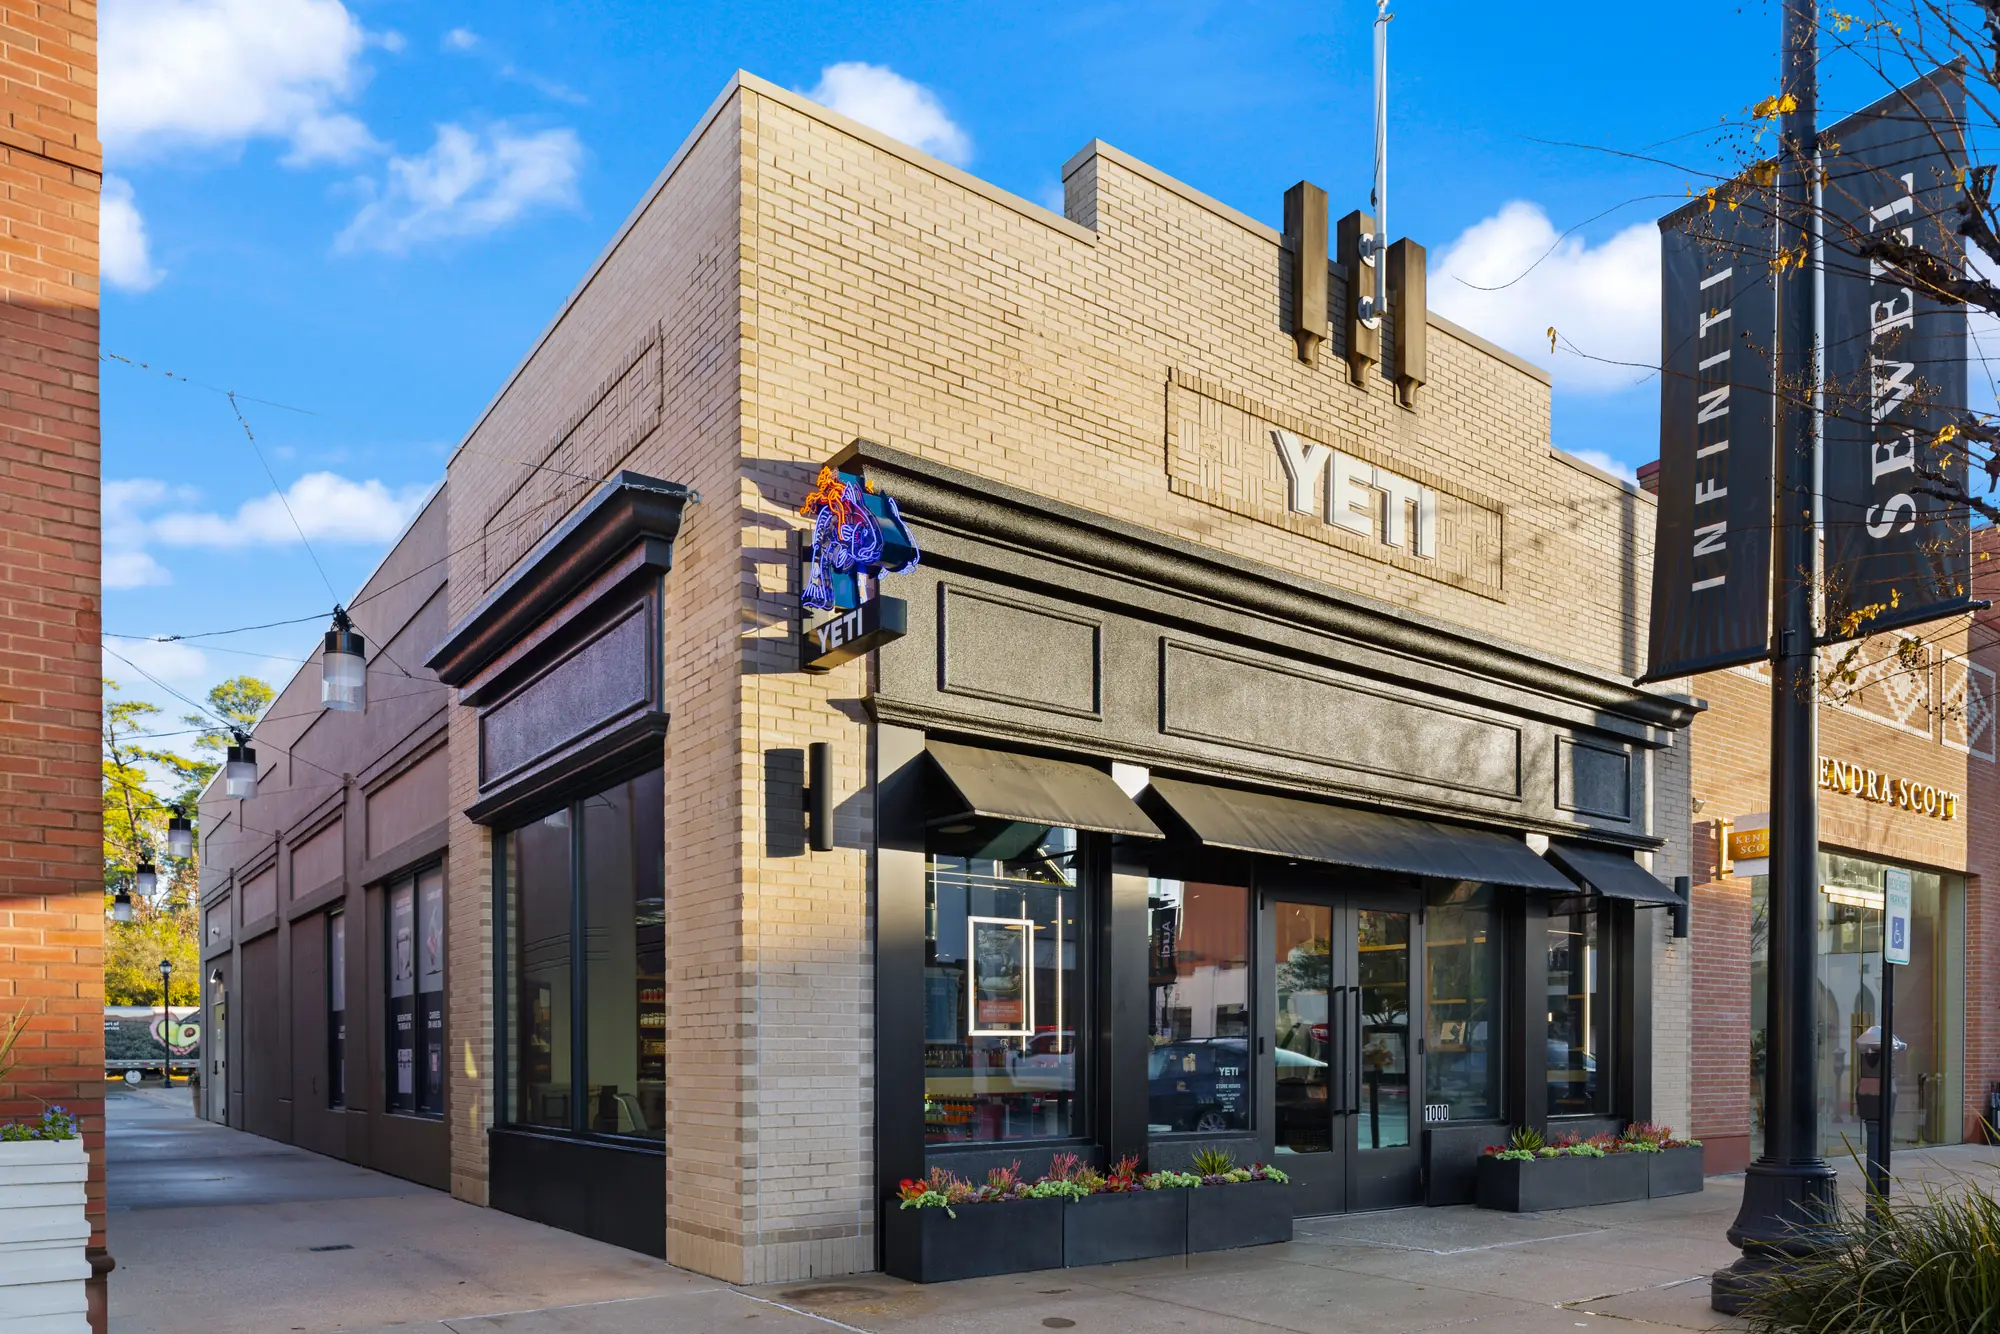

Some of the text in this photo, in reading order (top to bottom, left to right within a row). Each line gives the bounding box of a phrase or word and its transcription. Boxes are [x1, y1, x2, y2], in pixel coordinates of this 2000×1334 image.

[1692, 266, 1733, 592] INFINITI
[1273, 429, 1437, 561] YETI
[816, 607, 863, 654] YETI
[1818, 755, 1960, 820] ENDRA SCOTT
[1740, 843, 1769, 855] SCO
[1219, 1067, 1239, 1076] YETI
[1425, 1104, 1448, 1121] 1000
